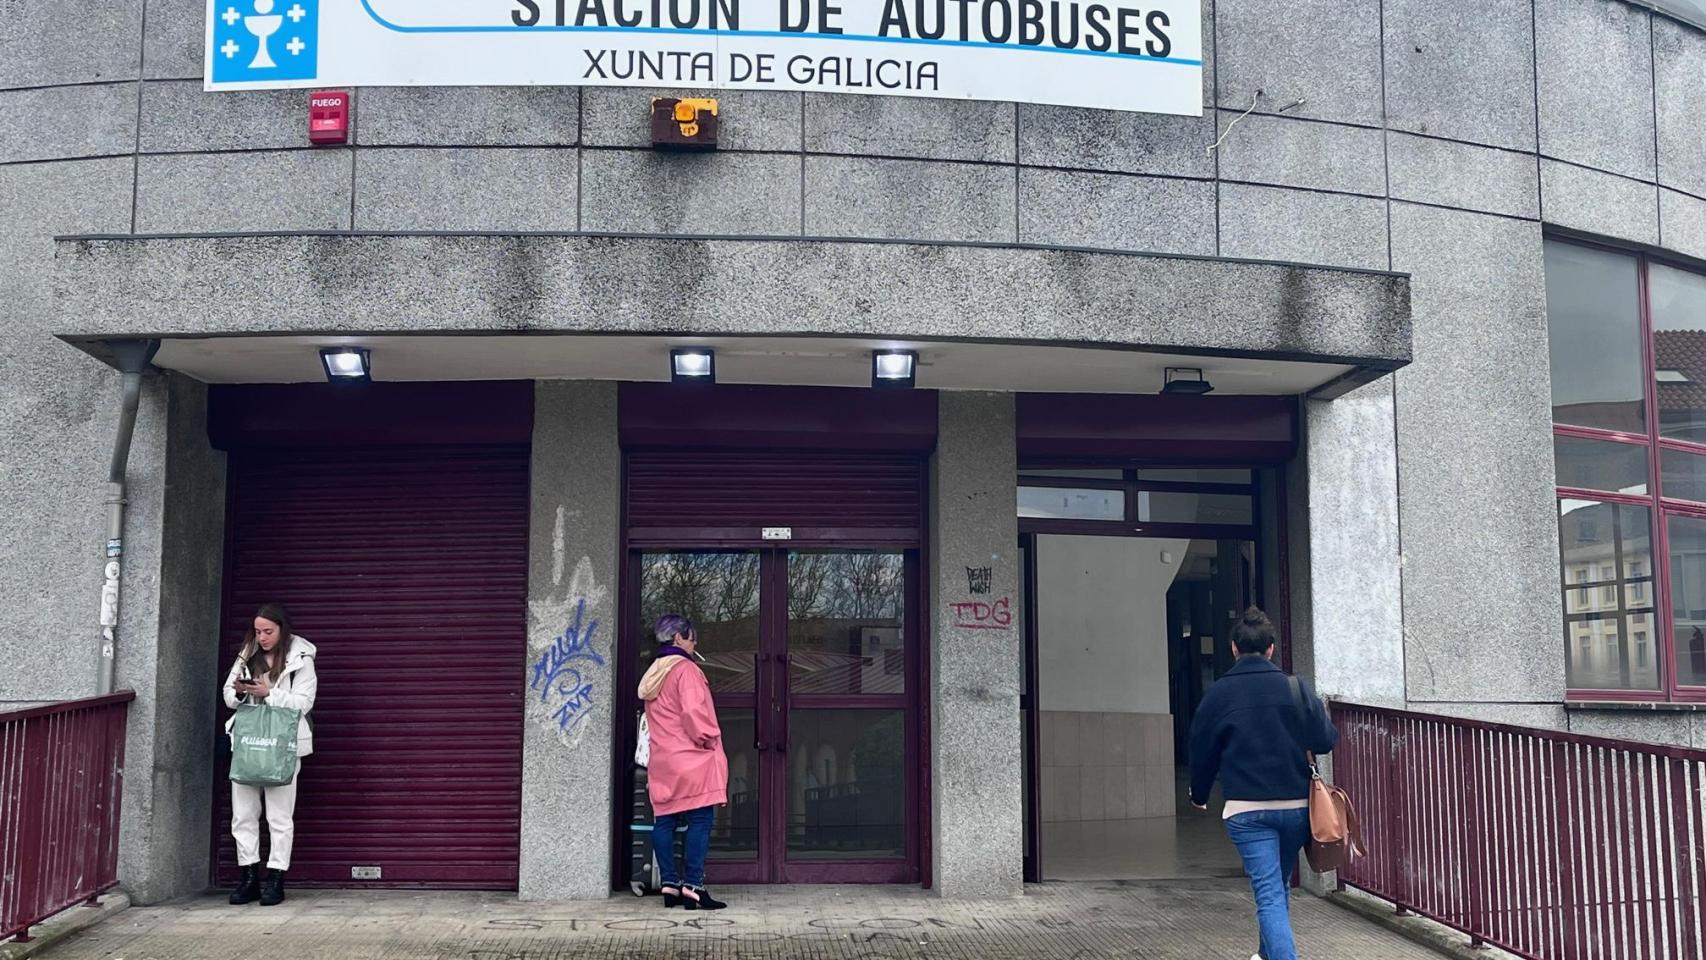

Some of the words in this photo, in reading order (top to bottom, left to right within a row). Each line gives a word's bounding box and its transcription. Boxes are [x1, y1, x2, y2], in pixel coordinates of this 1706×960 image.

[779, 0, 843, 35] DE
[878, 0, 1172, 58] AUTOBUSES
[583, 49, 714, 82] XUNTA
[729, 53, 776, 83] DE
[787, 54, 939, 91] GALICIA
[312, 98, 342, 107] FUEGO
[949, 596, 1011, 626] TDG
[482, 917, 735, 931] STOP
